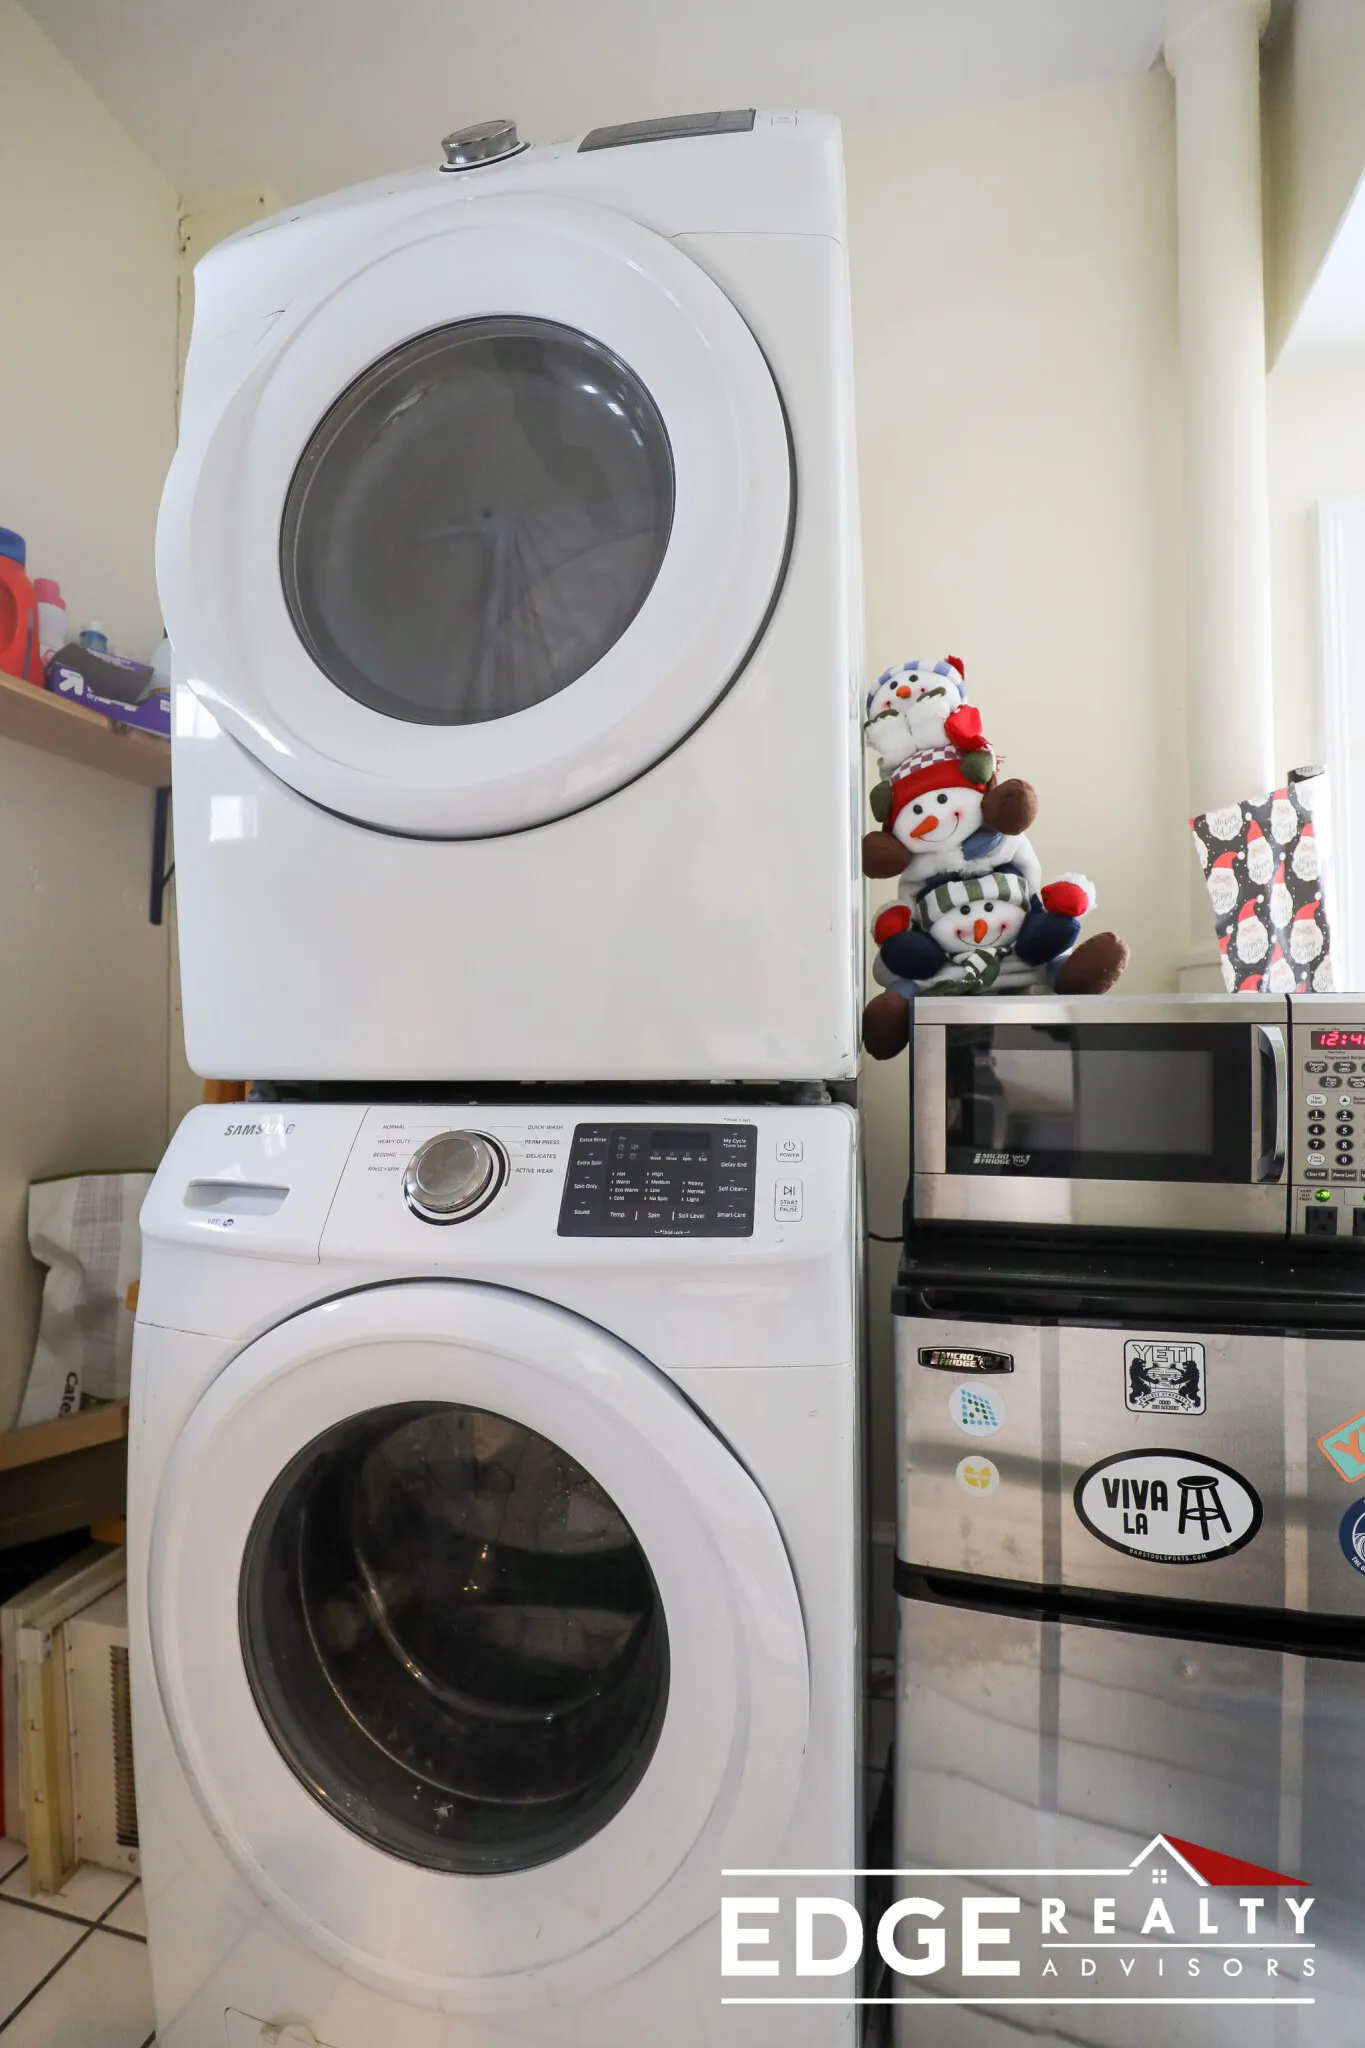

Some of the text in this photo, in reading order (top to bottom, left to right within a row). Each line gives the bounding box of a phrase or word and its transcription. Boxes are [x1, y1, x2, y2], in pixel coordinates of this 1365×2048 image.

[1320, 1033, 1365, 1047] 12:4
[940, 1351, 975, 1361] MICRO
[1132, 1344, 1193, 1363] YETI
[58, 1372, 79, 1417] Cate
[1101, 1477, 1168, 1512] VIVA
[1123, 1512, 1149, 1536] LA
[1128, 1547, 1208, 1562] BARSTOOLSPORTS.COM
[1351, 1556, 1362, 1568] THE
